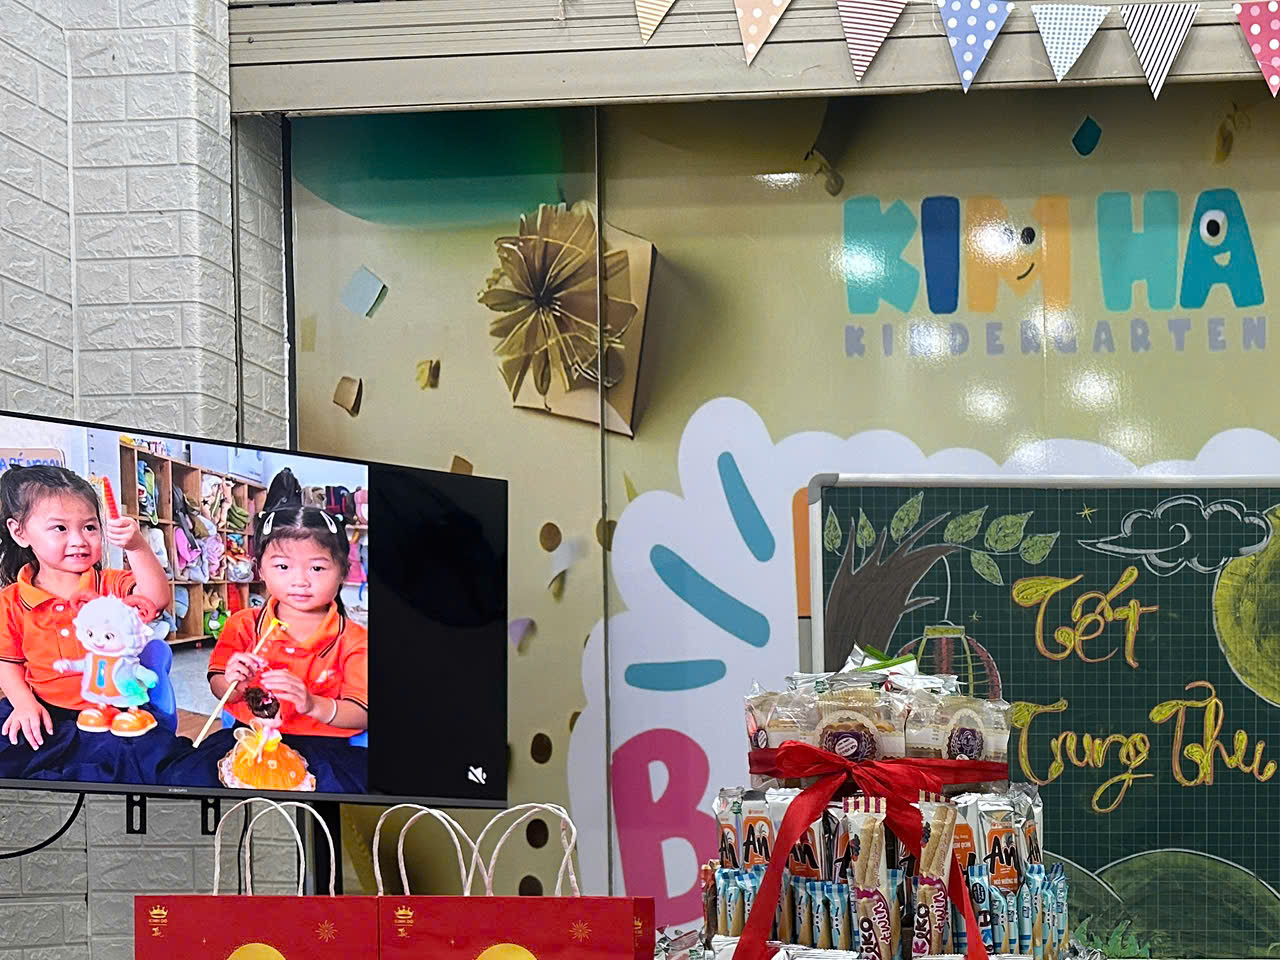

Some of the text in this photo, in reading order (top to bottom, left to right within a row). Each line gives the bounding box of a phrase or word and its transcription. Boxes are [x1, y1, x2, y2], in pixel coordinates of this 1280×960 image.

[843, 188, 1265, 314] KIM HA
[1012, 565, 1160, 669] Tết
[1010, 680, 1278, 814] Trung Thu
[719, 831, 740, 869] An
[743, 824, 771, 864] An
[984, 835, 1021, 877] An
[872, 902, 892, 945] twin
[931, 891, 945, 933] twin
